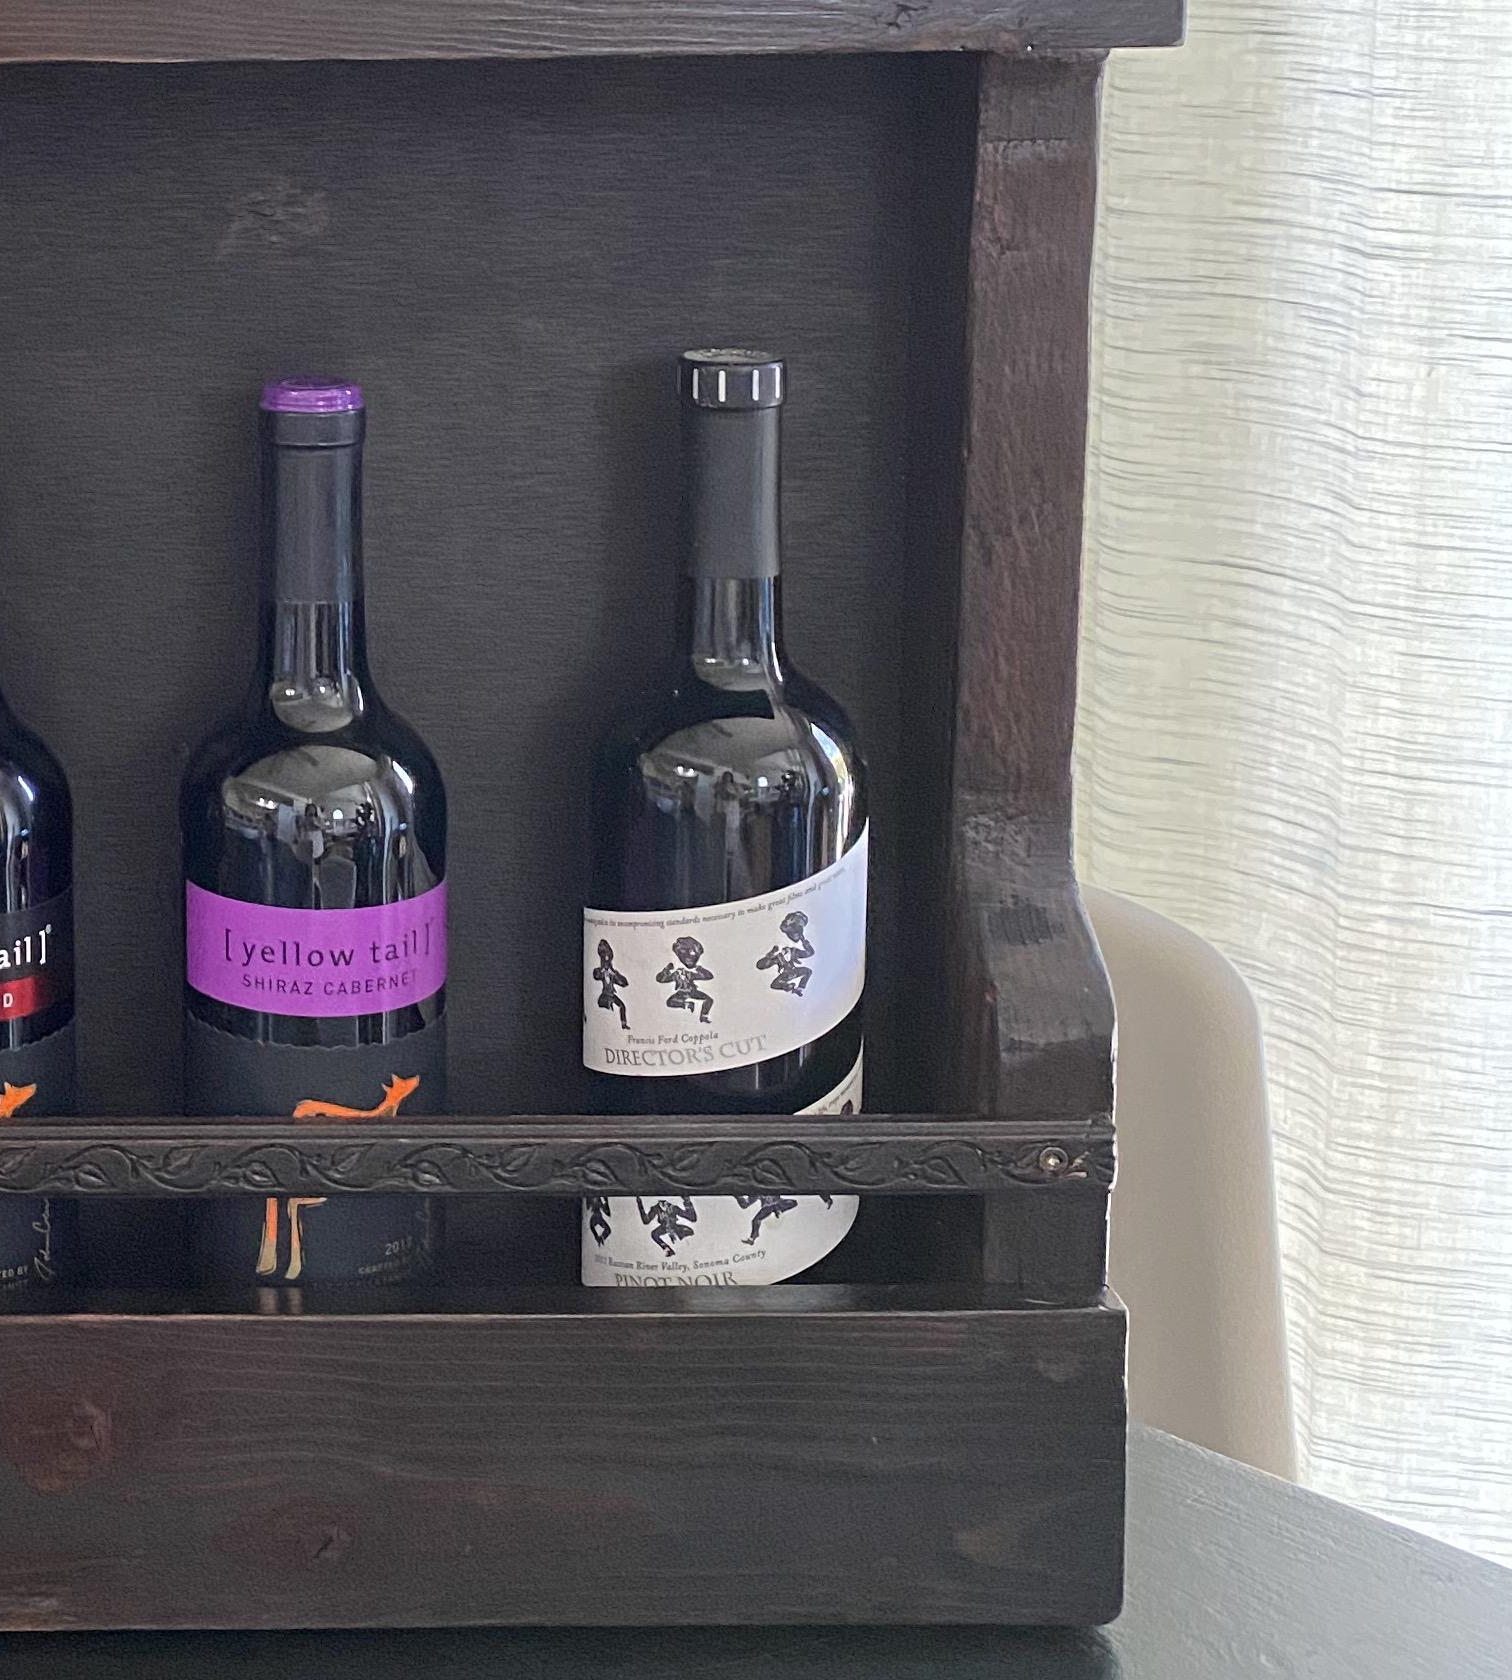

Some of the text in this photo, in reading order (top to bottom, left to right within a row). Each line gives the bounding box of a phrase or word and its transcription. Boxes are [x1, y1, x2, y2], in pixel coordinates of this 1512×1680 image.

[241, 973, 313, 995] SHIRAZ
[627, 1030, 719, 1046] Francis Ford Coppola
[604, 1034, 767, 1067] DIRECTOR'S CUT
[636, 1260, 659, 1271] River
[692, 1259, 729, 1269] Sonoma
[732, 1249, 767, 1264] County
[614, 1270, 738, 1288] PINOT NOIR
